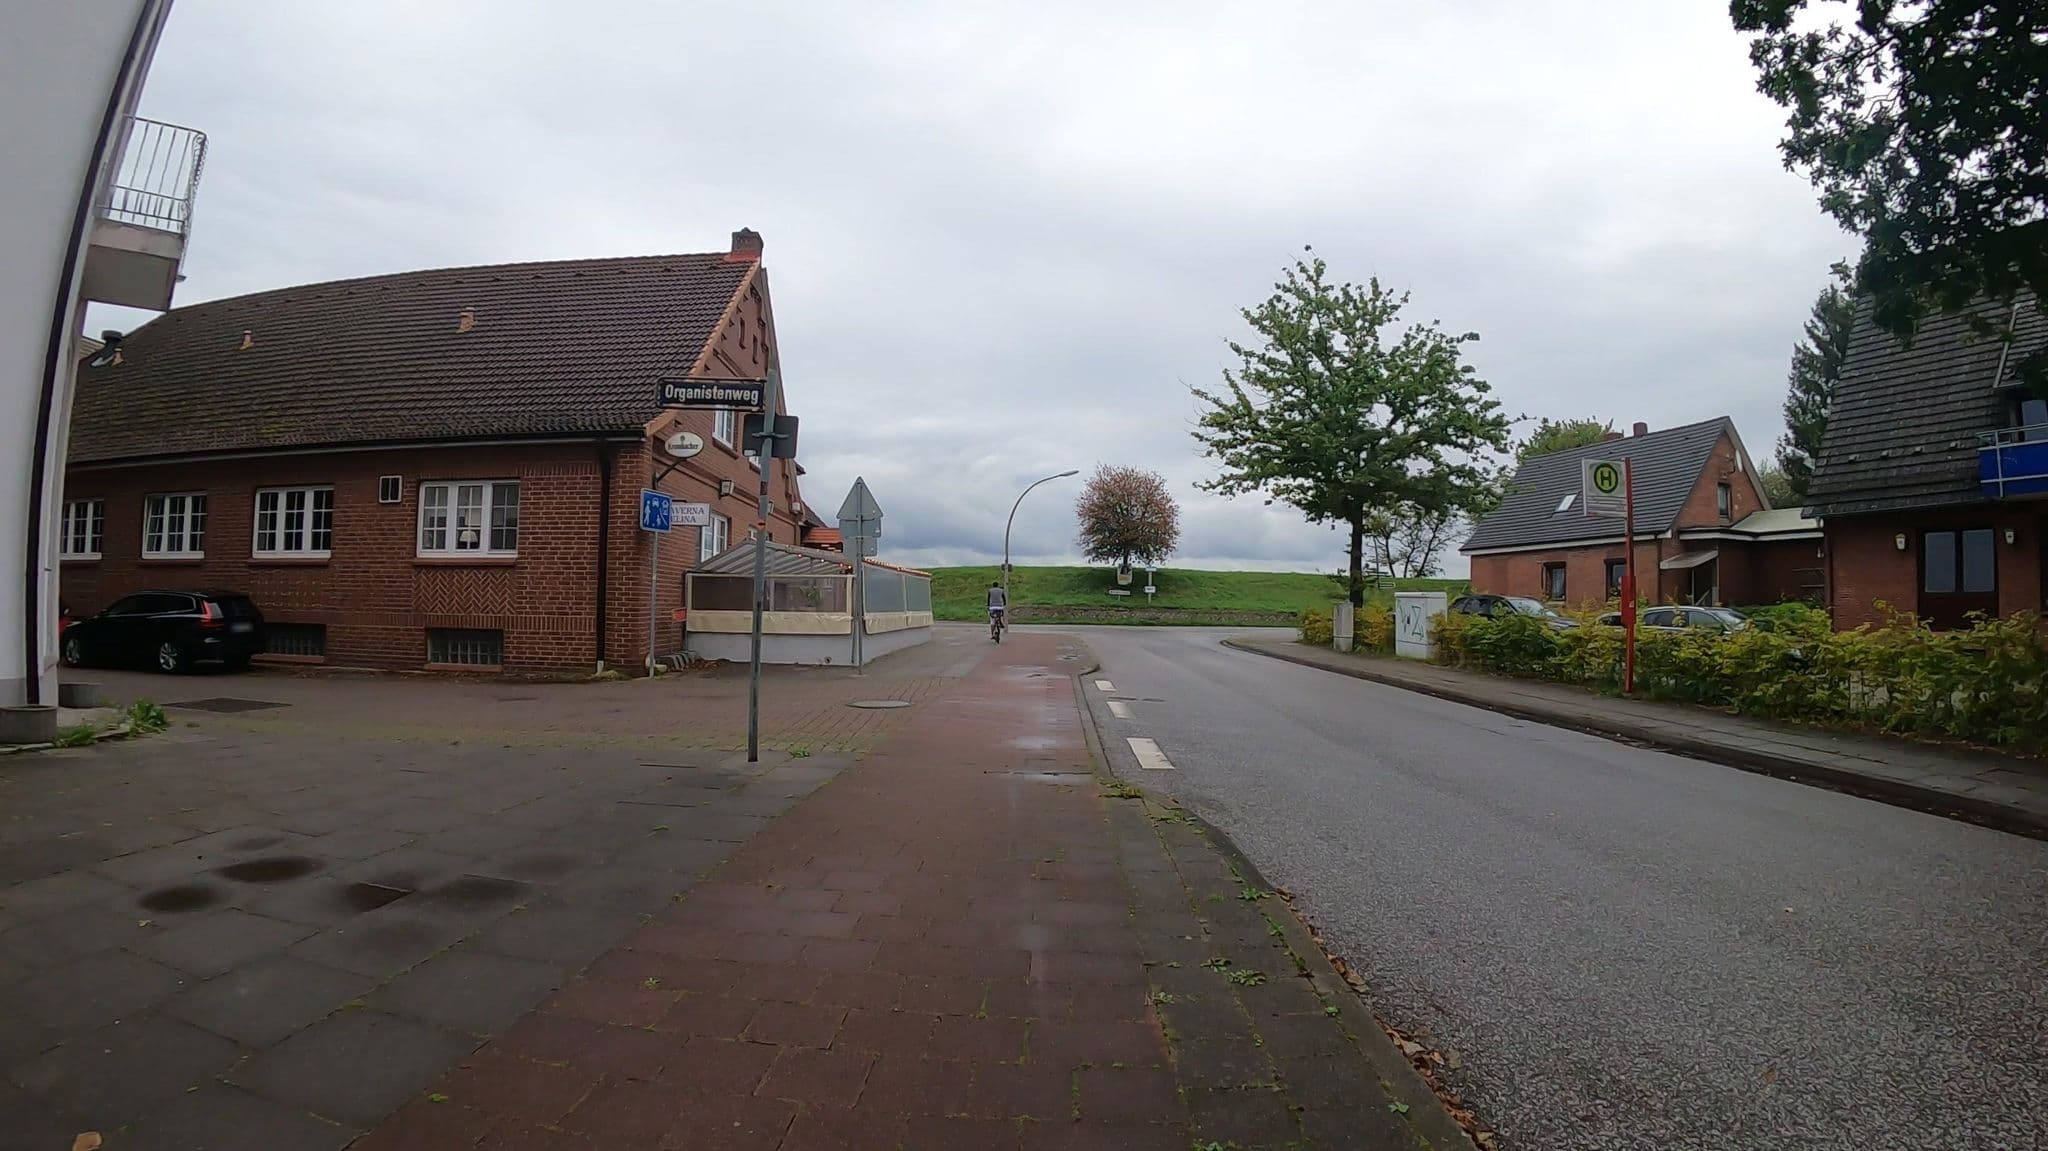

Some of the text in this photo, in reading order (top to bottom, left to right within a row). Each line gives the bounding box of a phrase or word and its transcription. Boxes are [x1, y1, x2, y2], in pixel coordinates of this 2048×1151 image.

[665, 384, 759, 405] Organistenweg
[667, 440, 699, 450] Kbachr
[1601, 470, 1612, 487] H
[671, 506, 705, 515] AVERNA
